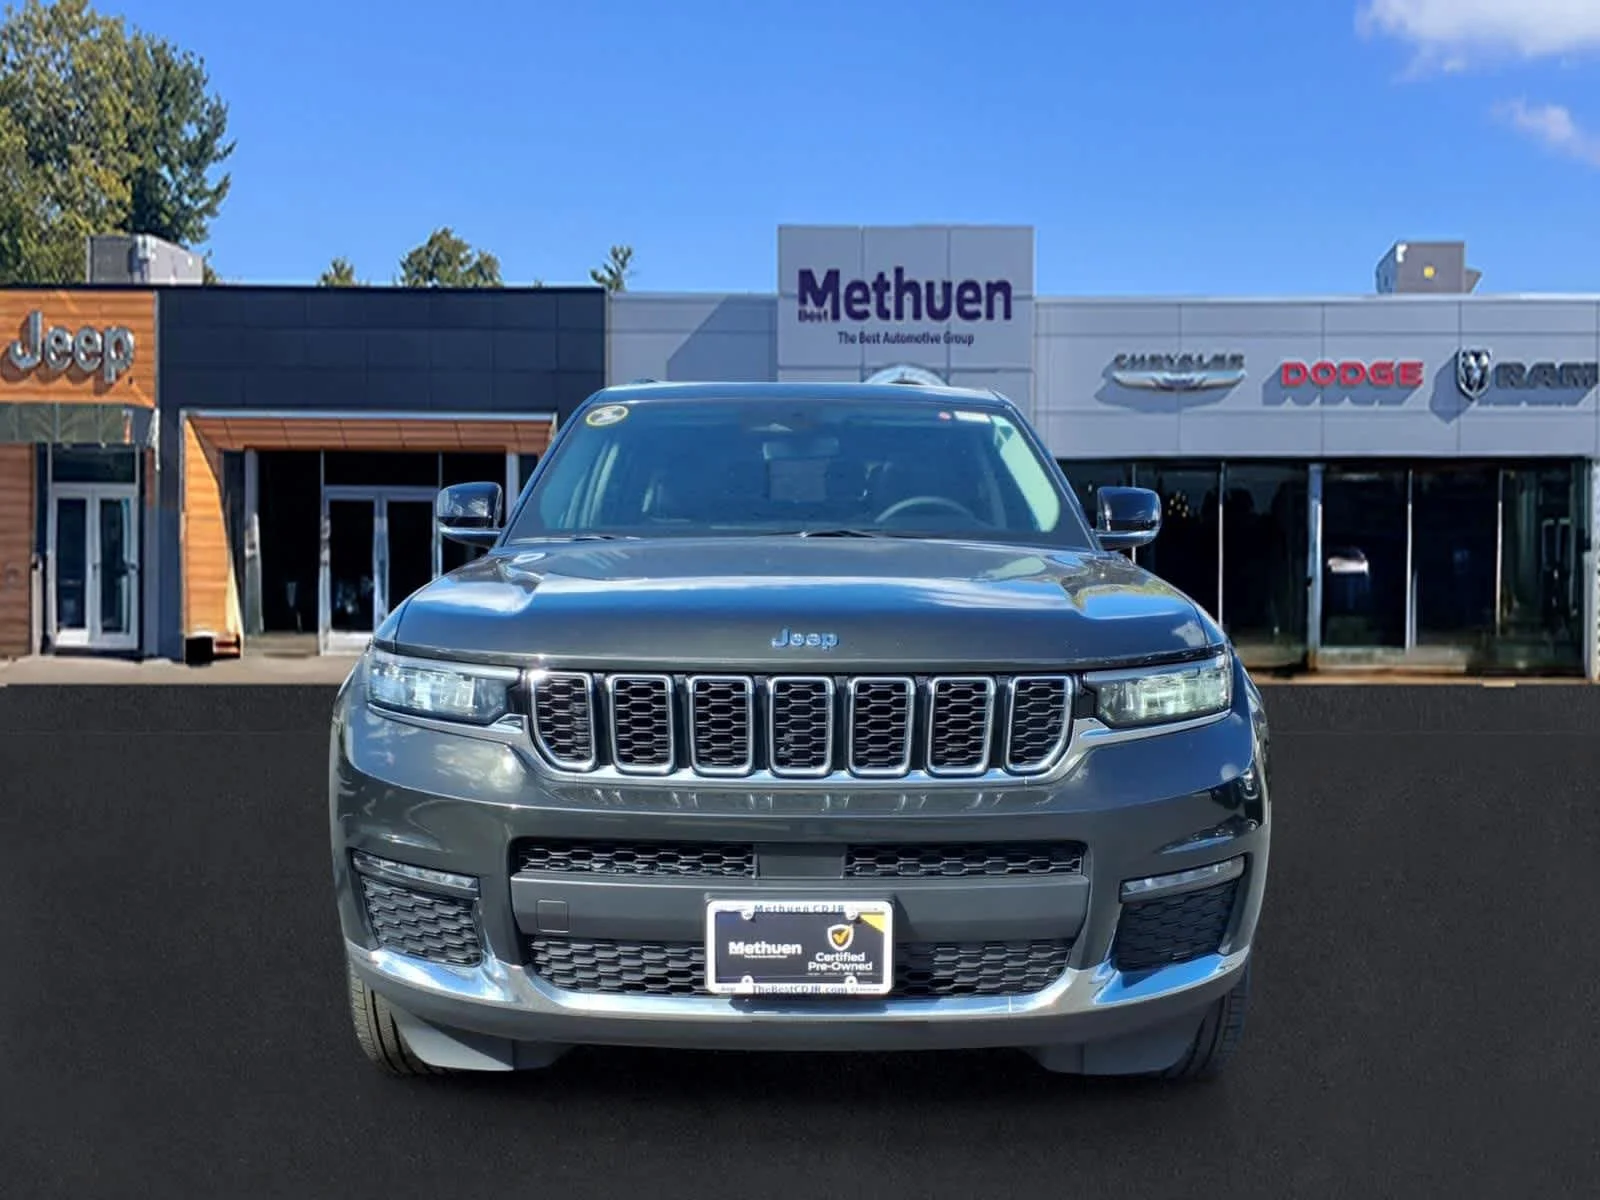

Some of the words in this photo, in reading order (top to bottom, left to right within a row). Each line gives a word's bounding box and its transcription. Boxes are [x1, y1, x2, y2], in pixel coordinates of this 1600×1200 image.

[797, 266, 1013, 322] Methuen
[8, 310, 136, 384] Jeep
[838, 331, 858, 345] The
[859, 331, 881, 344] Best
[883, 331, 941, 345] Automotive
[943, 331, 974, 346] Group
[1113, 353, 1244, 369] CHRYSLER
[1280, 361, 1424, 386] DODGE
[1493, 362, 1599, 389] RAM
[771, 627, 840, 651] Jeep
[728, 940, 802, 955] Methuen
[815, 952, 865, 962] Certified
[807, 961, 873, 971] Pre-Owned
